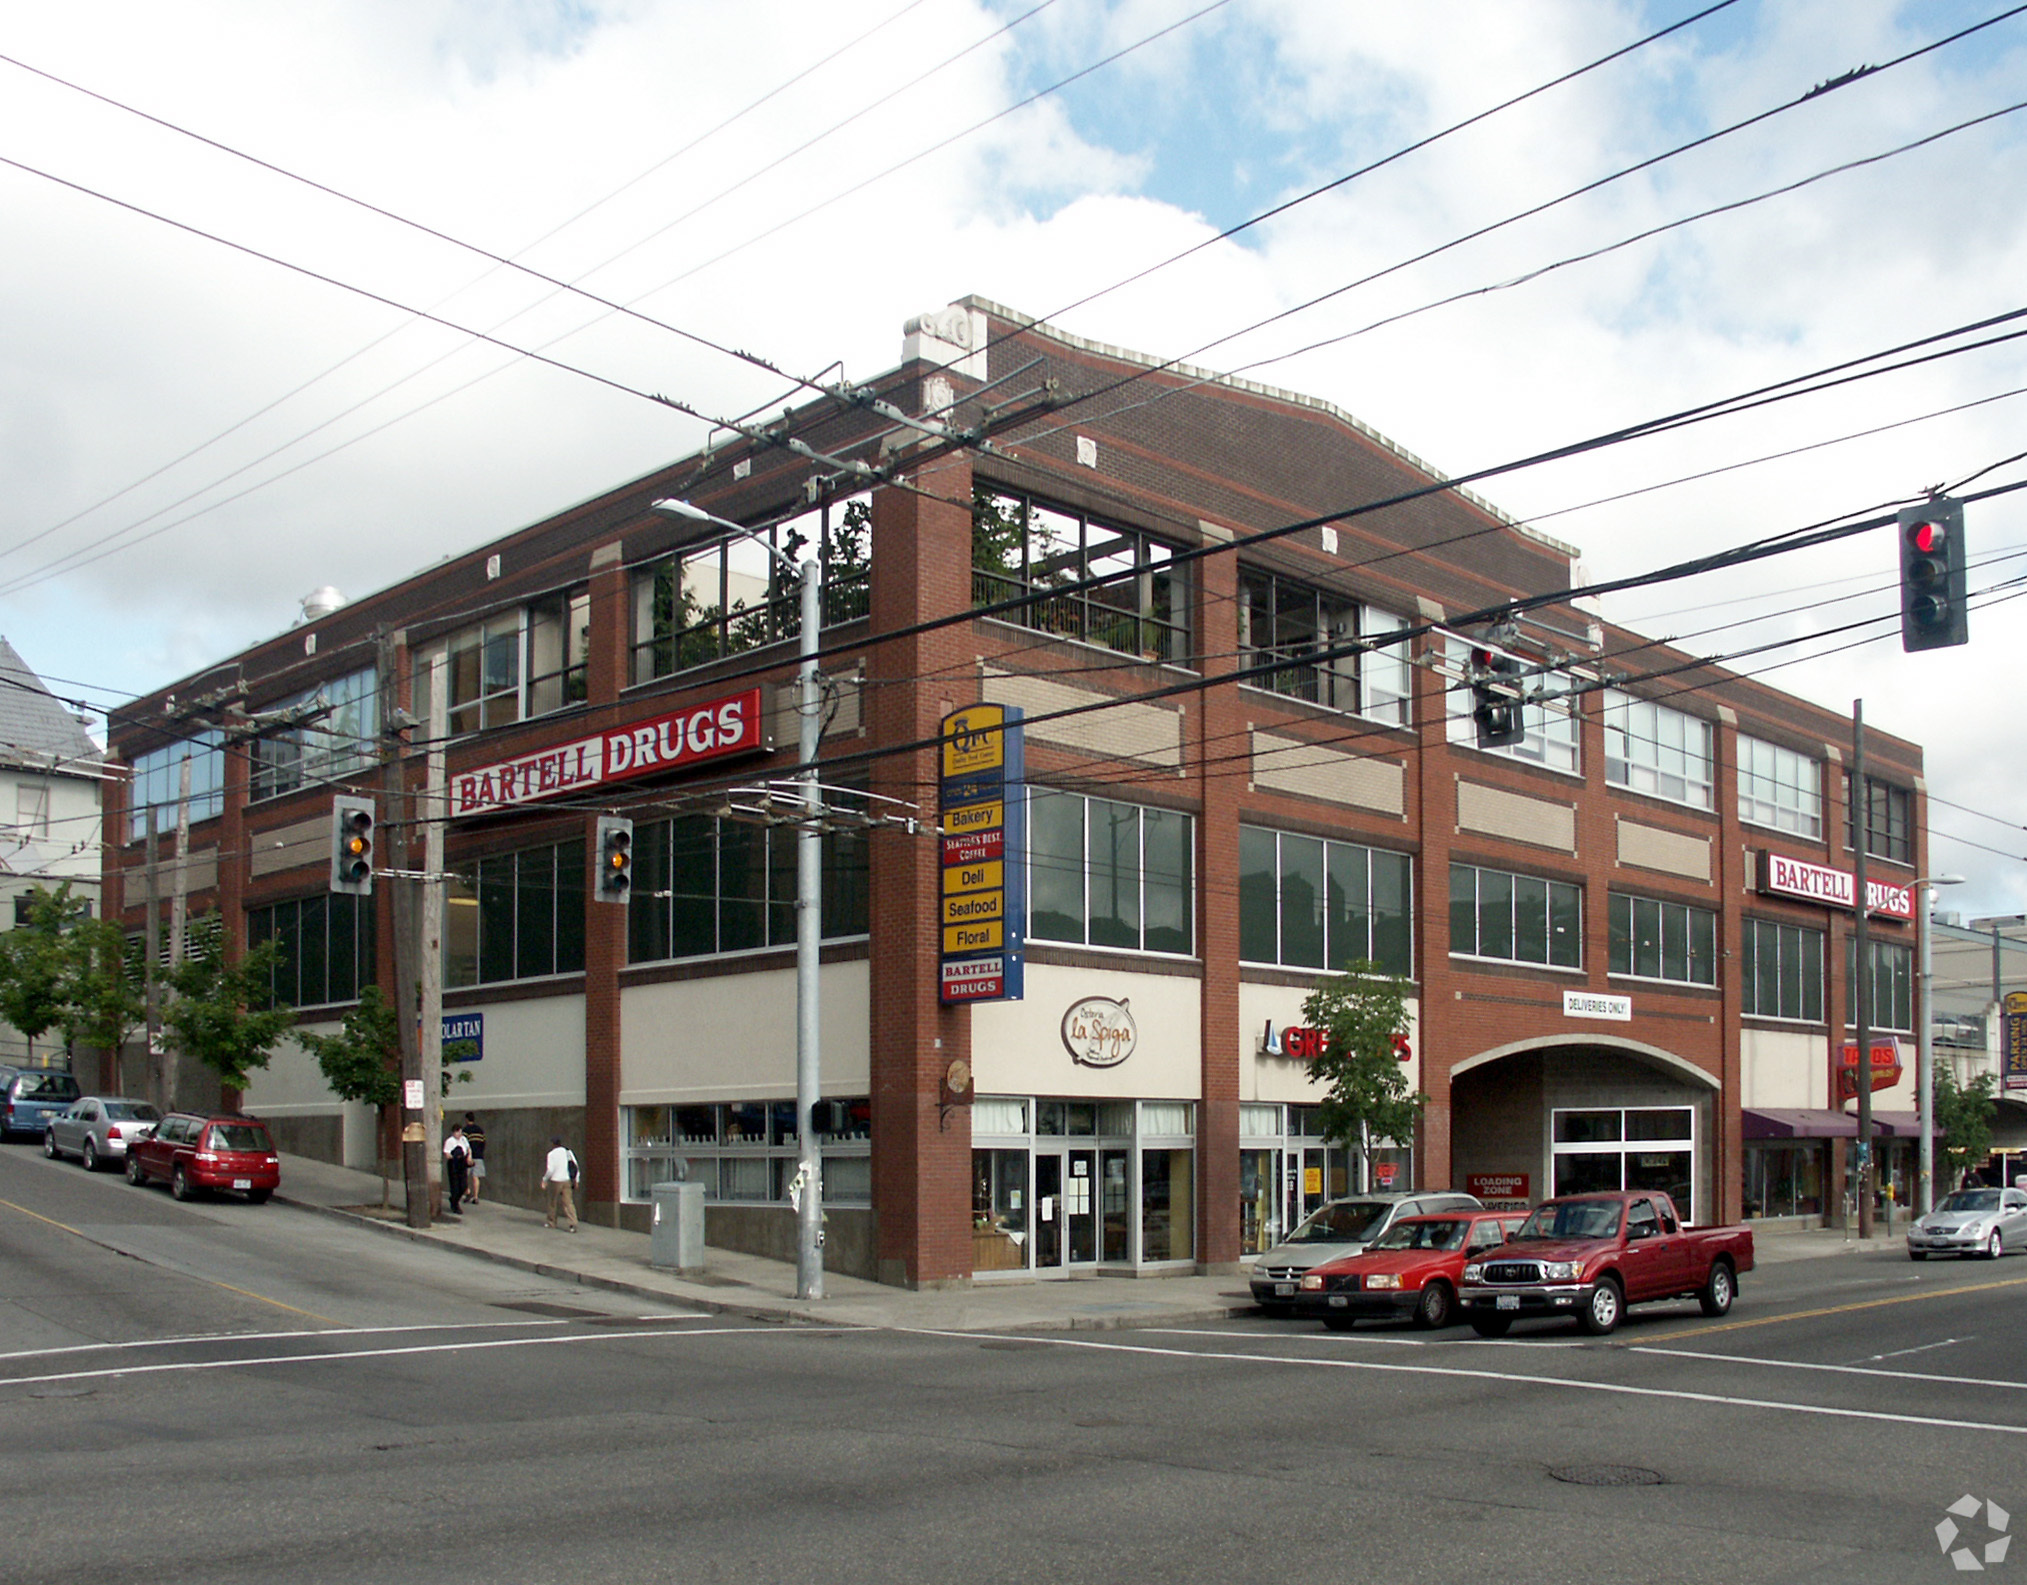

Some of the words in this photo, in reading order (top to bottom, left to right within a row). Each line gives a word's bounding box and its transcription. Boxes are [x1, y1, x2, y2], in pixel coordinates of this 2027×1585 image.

[460, 746, 594, 812] BARTELL
[608, 700, 744, 775] DRUGS
[953, 809, 993, 826] Bakery
[982, 832, 1000, 844] BEST
[960, 848, 986, 860] COFFEE
[962, 868, 984, 885] Deli
[1776, 860, 1849, 901] BARTELL
[1866, 881, 1910, 914] RUGS
[949, 897, 997, 917] Seafood
[957, 928, 989, 945] Floral
[945, 962, 1001, 977] BARTELL
[950, 981, 996, 995] DRUGS
[1569, 998, 1607, 1013] DELIVERIES
[441, 1022, 463, 1039] OLAR
[464, 1020, 481, 1037] TAN
[2010, 1017, 2021, 1070] PARKING
[1474, 1177, 1522, 1186] LOADING
[1483, 1186, 1512, 1194] ZONE
